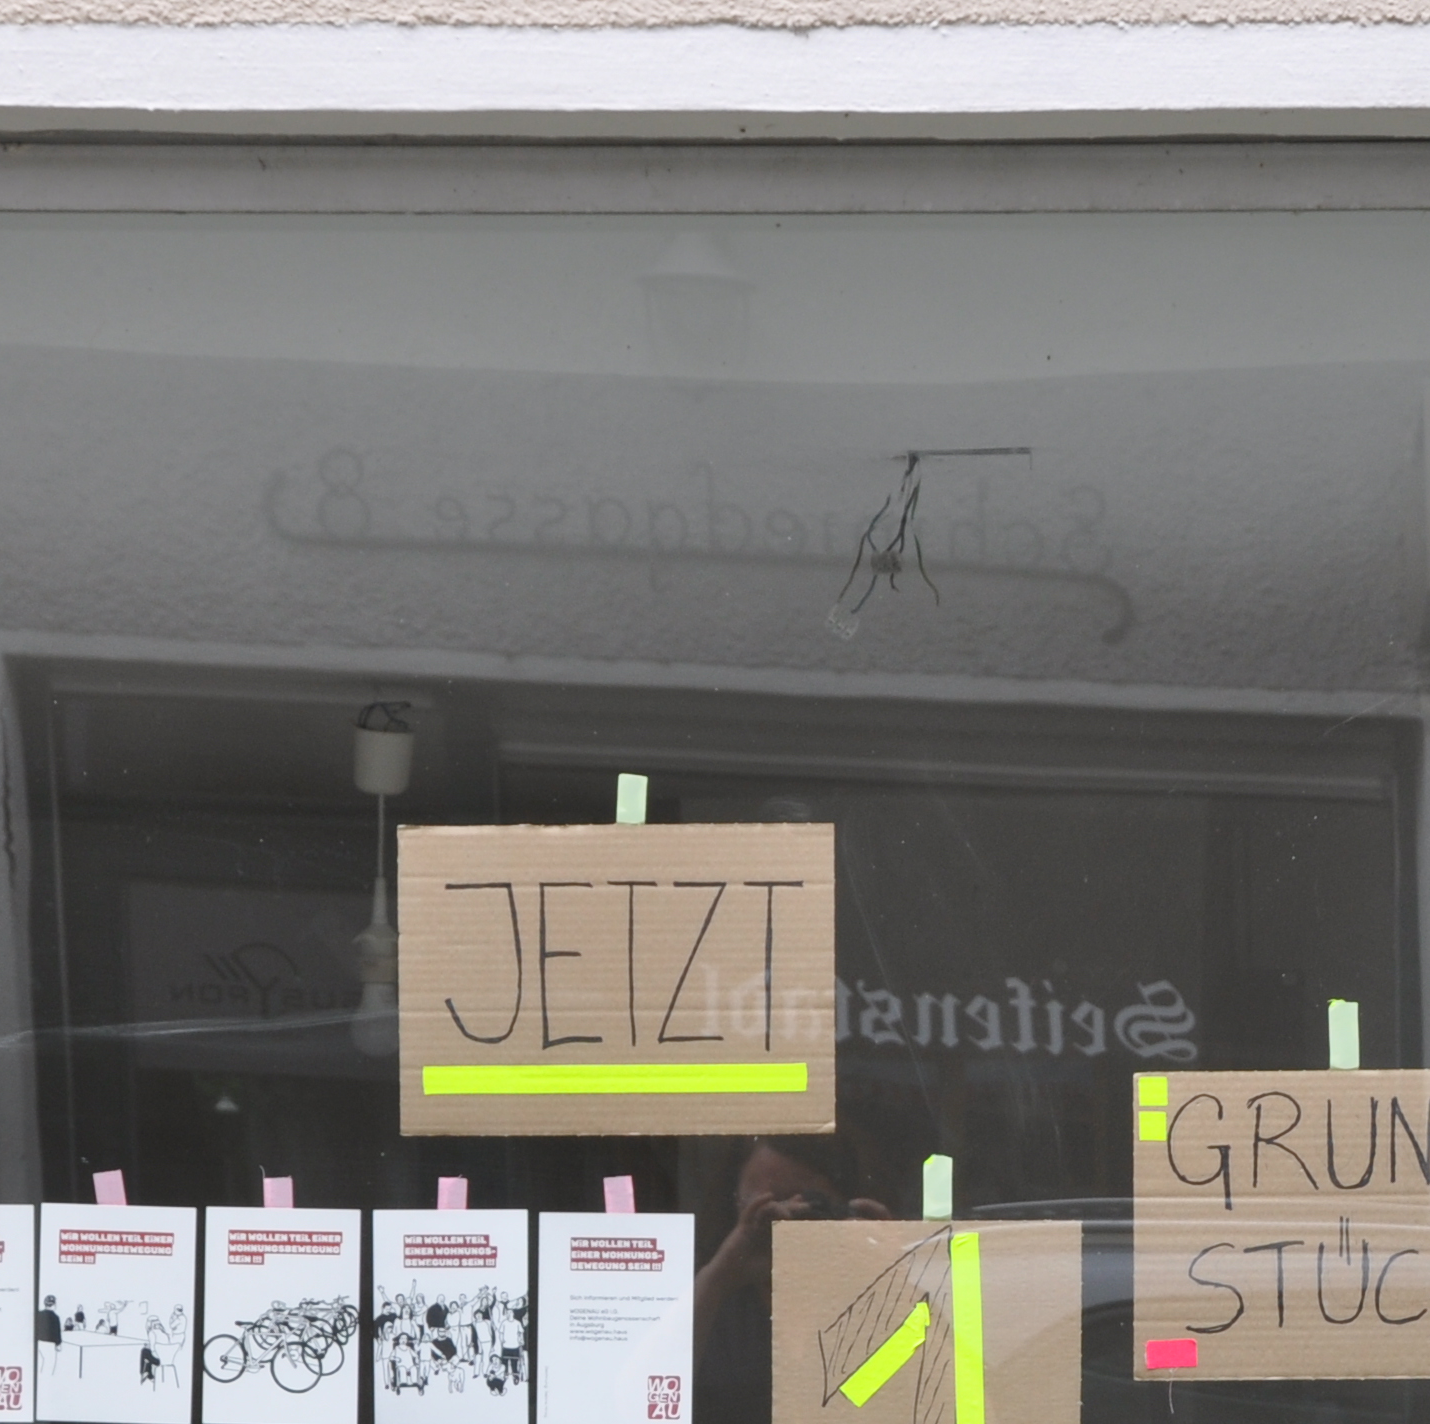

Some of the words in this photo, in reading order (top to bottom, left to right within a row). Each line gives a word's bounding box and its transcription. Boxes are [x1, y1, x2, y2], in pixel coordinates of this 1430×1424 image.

[443, 880, 805, 1052] JETZT
[80, 1233, 120, 1242] WOLLEN
[248, 1233, 288, 1241] WOLLEN
[424, 1236, 464, 1244] WOLLEN
[590, 1239, 630, 1248] WOLLEN
[61, 1244, 172, 1254] WOHNUNGSBEWEGUNG
[229, 1244, 340, 1254] WOHNUNGSBEWEGUNG
[435, 1247, 496, 1256] WOHNUNGS-
[601, 1251, 663, 1259] WOHNUNGS-
[404, 1258, 460, 1267] BEWEGUNG
[571, 1262, 626, 1270] BEWEGUNG
[648, 1377, 679, 1392] WO
[649, 1392, 679, 1402] GEN
[651, 1402, 680, 1418] AU
